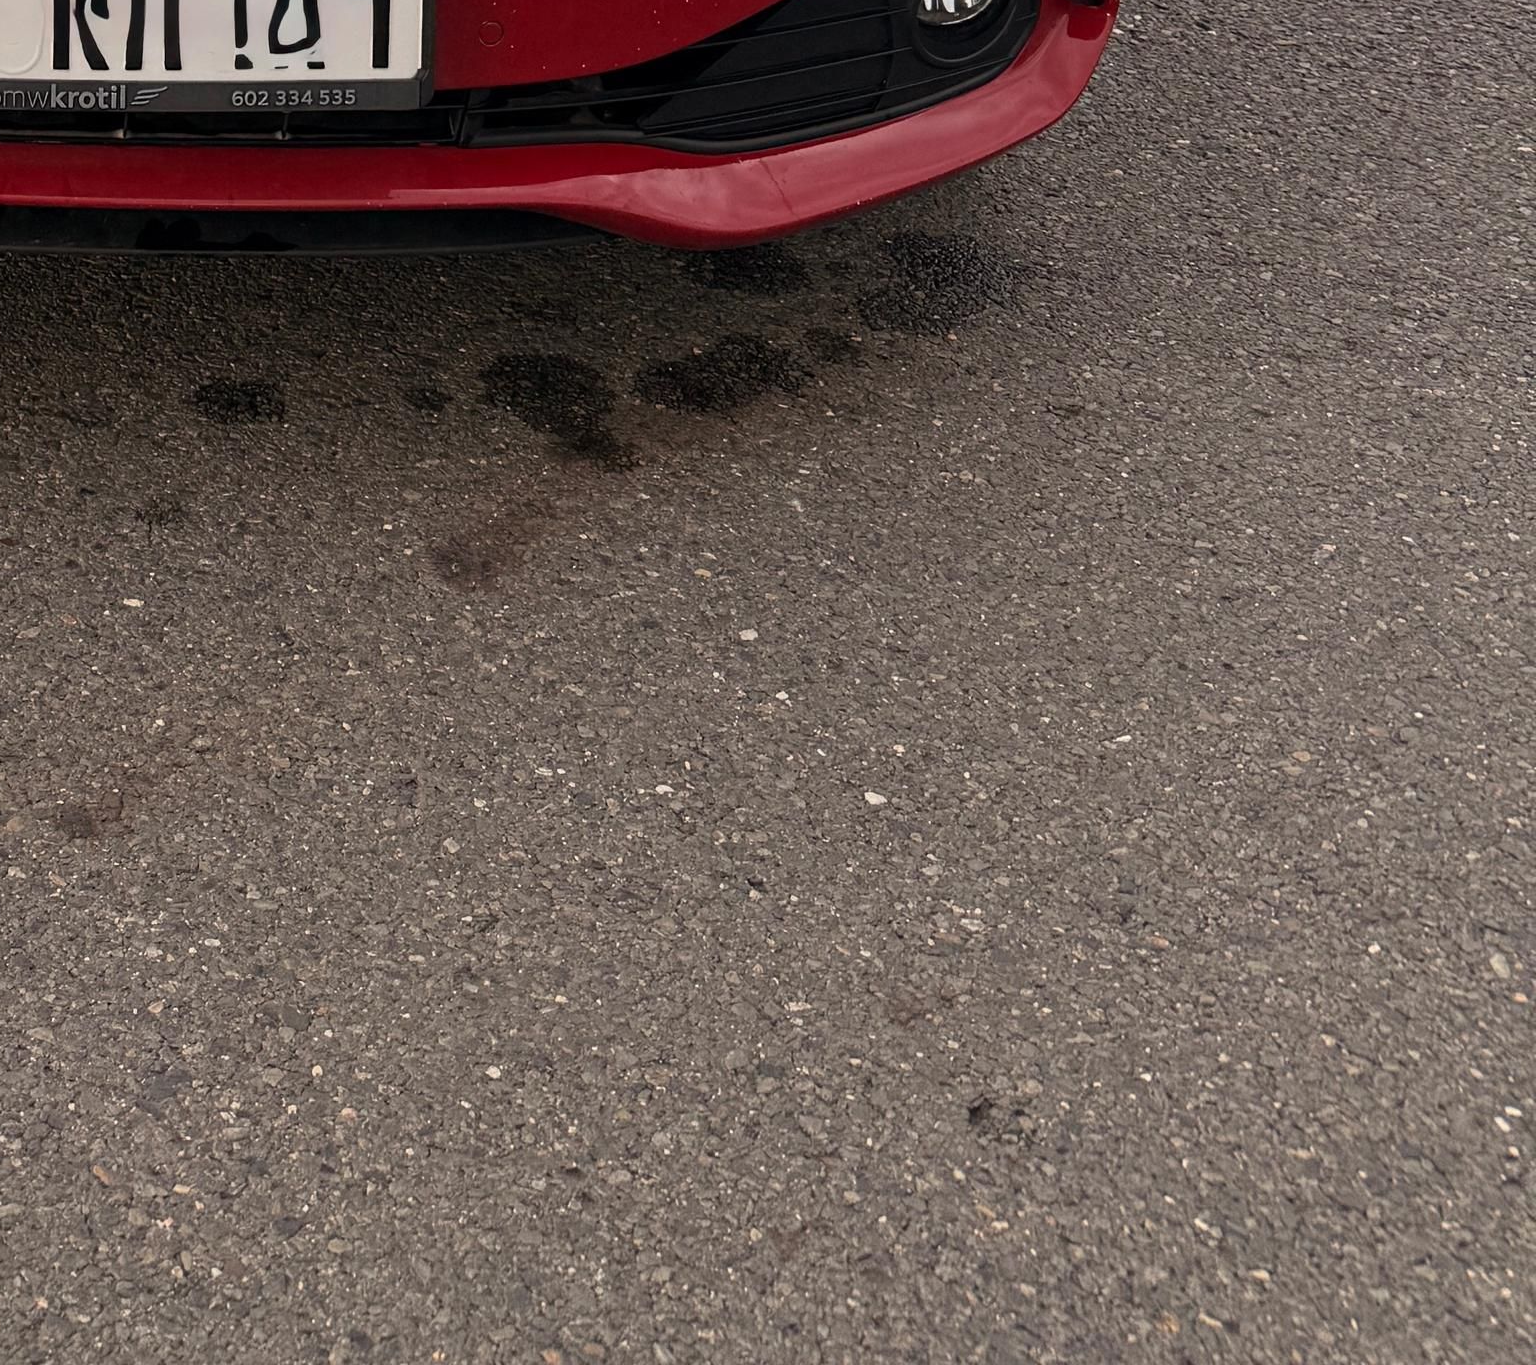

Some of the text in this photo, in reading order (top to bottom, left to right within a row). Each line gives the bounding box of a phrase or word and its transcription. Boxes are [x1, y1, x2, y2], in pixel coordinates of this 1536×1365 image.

[232, 88, 356, 107] 602 334 535
